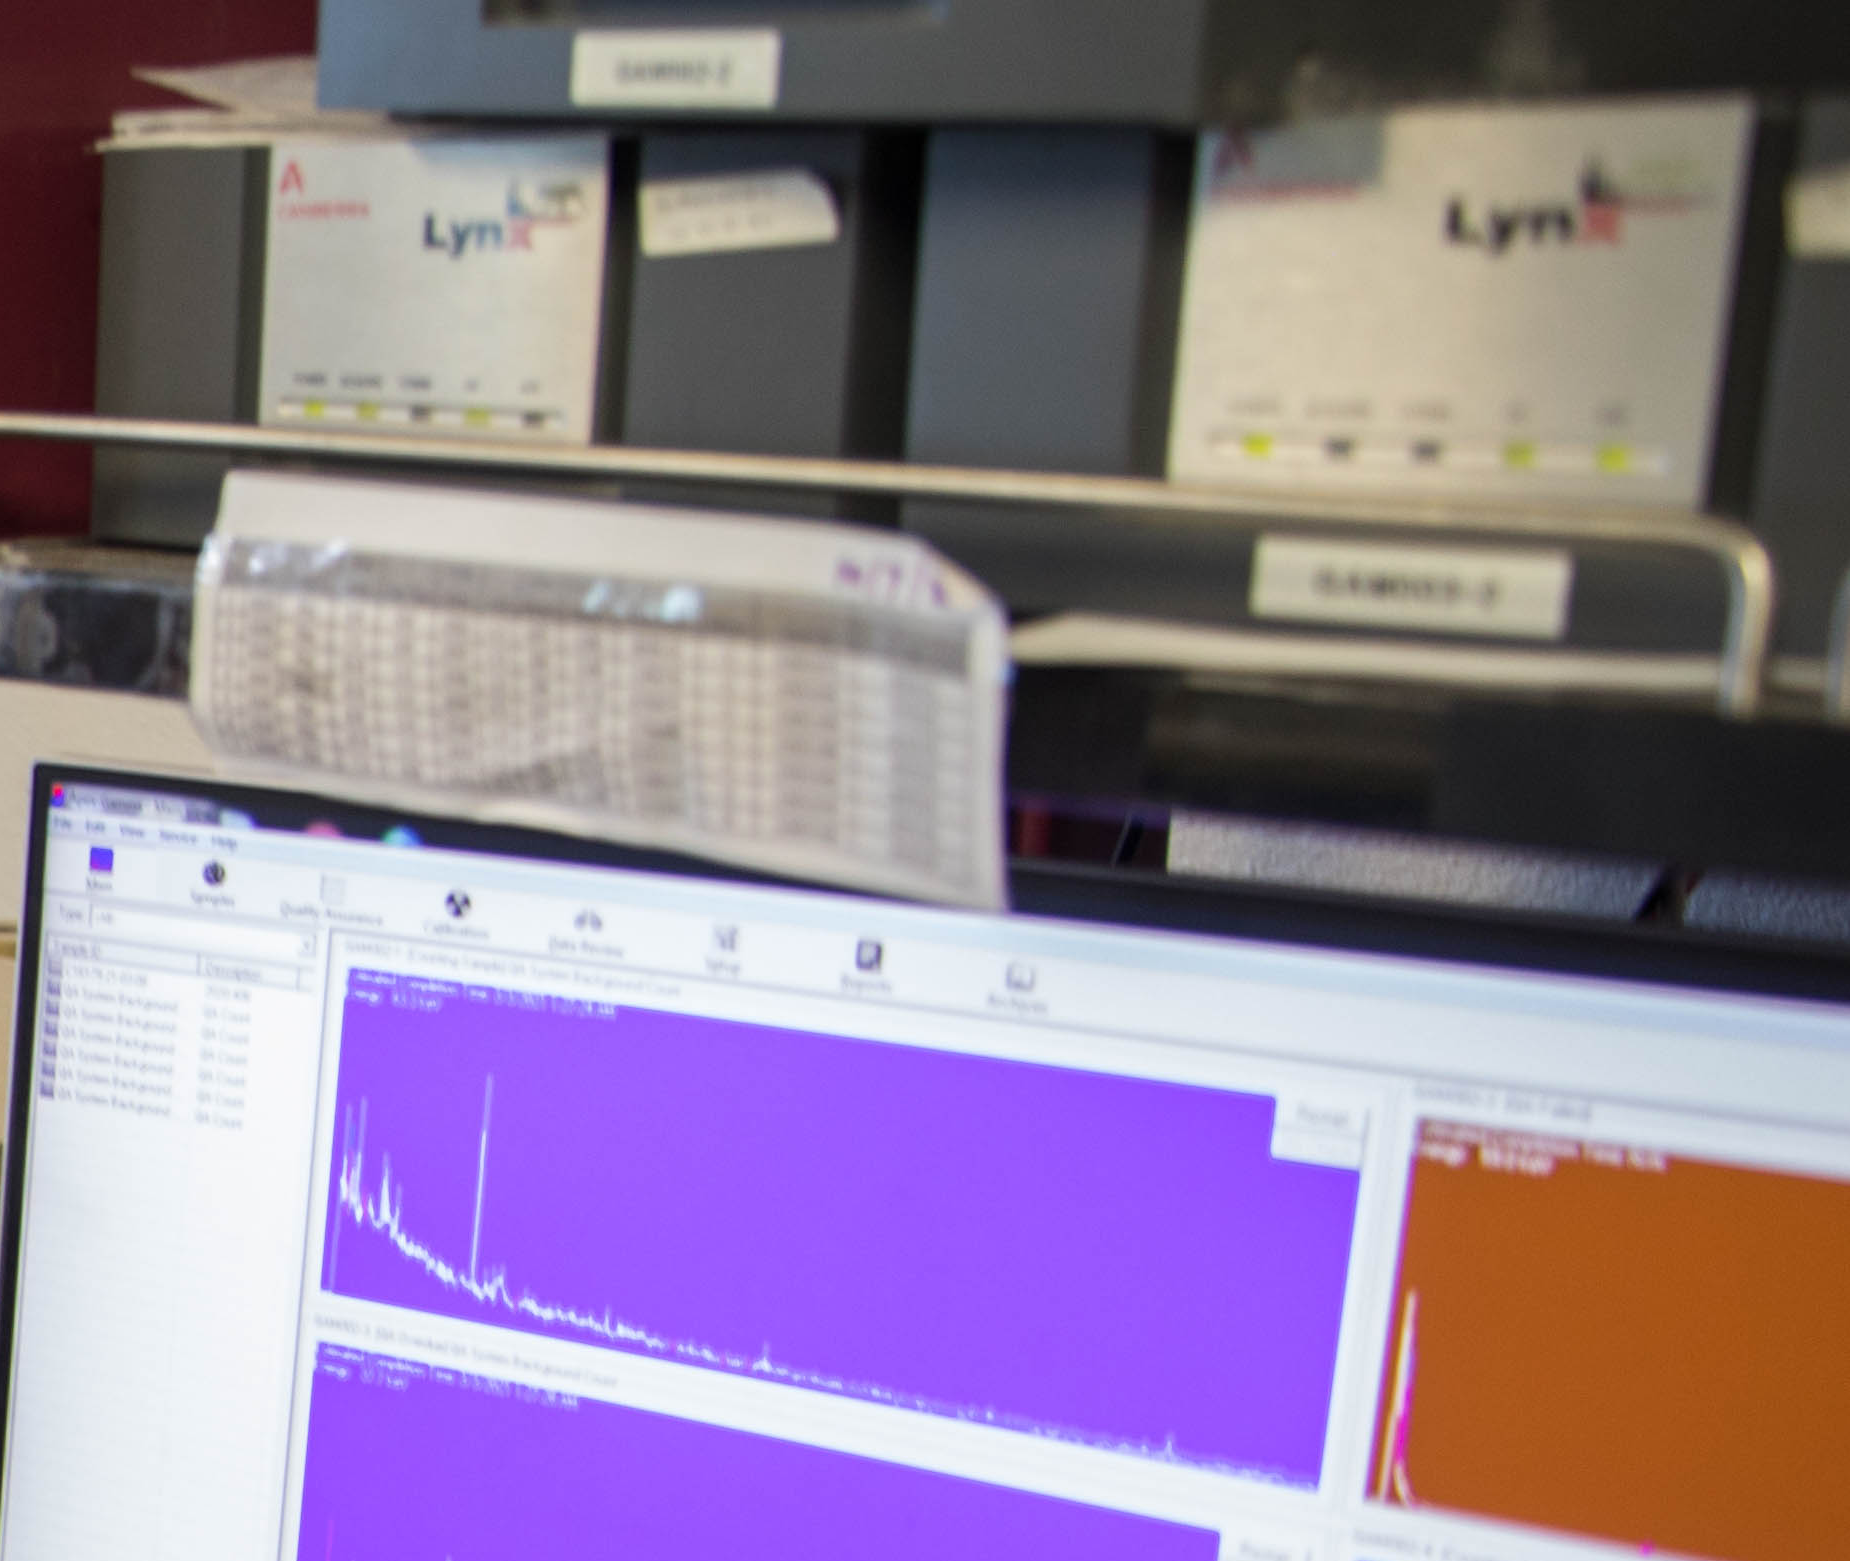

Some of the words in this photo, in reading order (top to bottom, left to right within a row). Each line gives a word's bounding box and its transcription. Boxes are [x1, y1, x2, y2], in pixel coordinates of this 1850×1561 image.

[422, 211, 534, 260] Lynx
[1442, 192, 1623, 257] Lynx
[119, 825, 145, 838] View
[211, 834, 238, 850] Help
[279, 901, 320, 919] Quality
[324, 905, 384, 925] Assurance
